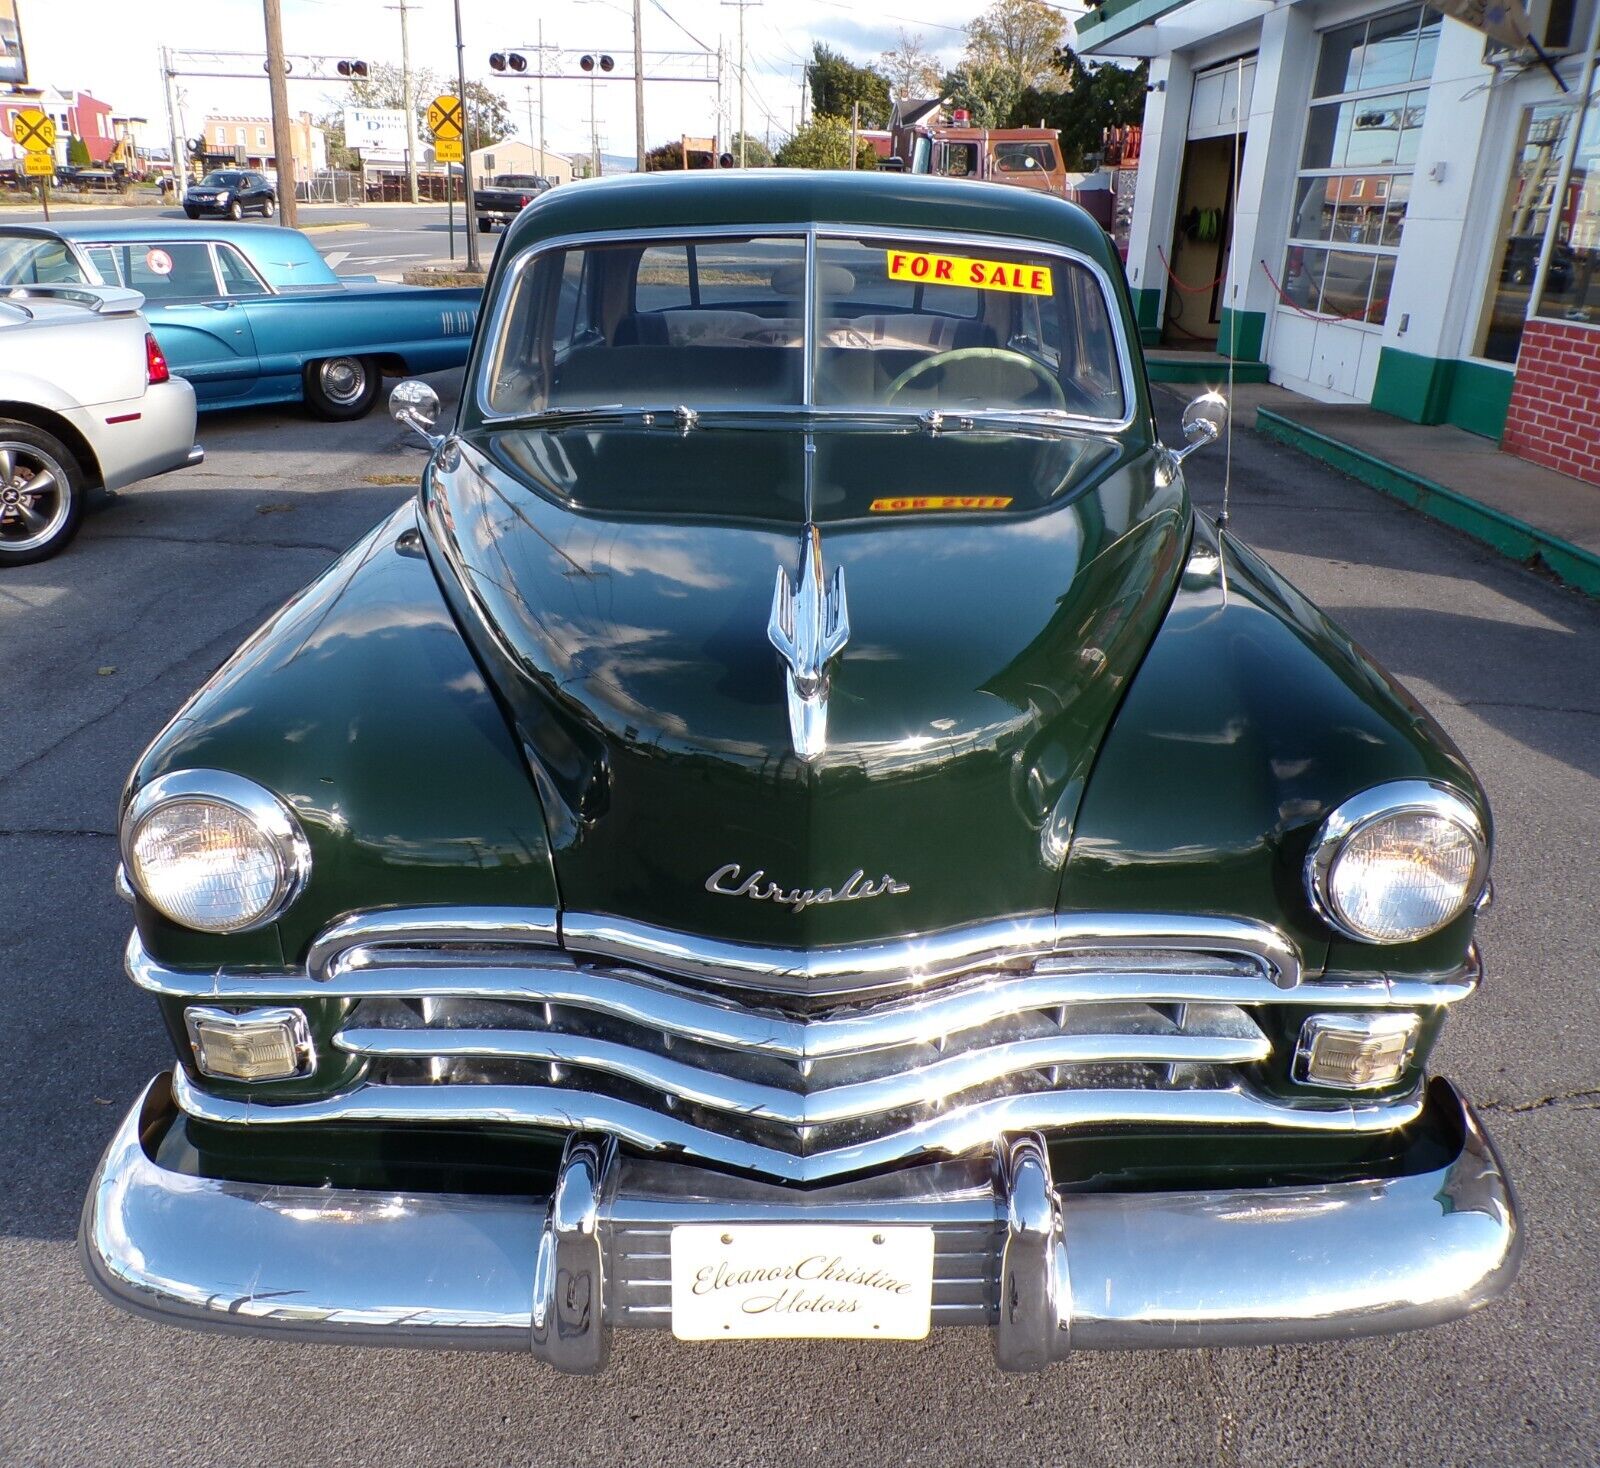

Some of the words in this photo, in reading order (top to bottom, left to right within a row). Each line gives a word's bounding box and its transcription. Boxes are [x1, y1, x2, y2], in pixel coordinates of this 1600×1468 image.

[891, 254, 954, 281] FOR
[969, 262, 1047, 291] SALE
[704, 862, 912, 914] Chrysler
[691, 1261, 796, 1296] Eleanor
[794, 1255, 913, 1296] Christine
[741, 1287, 862, 1315] Motors
